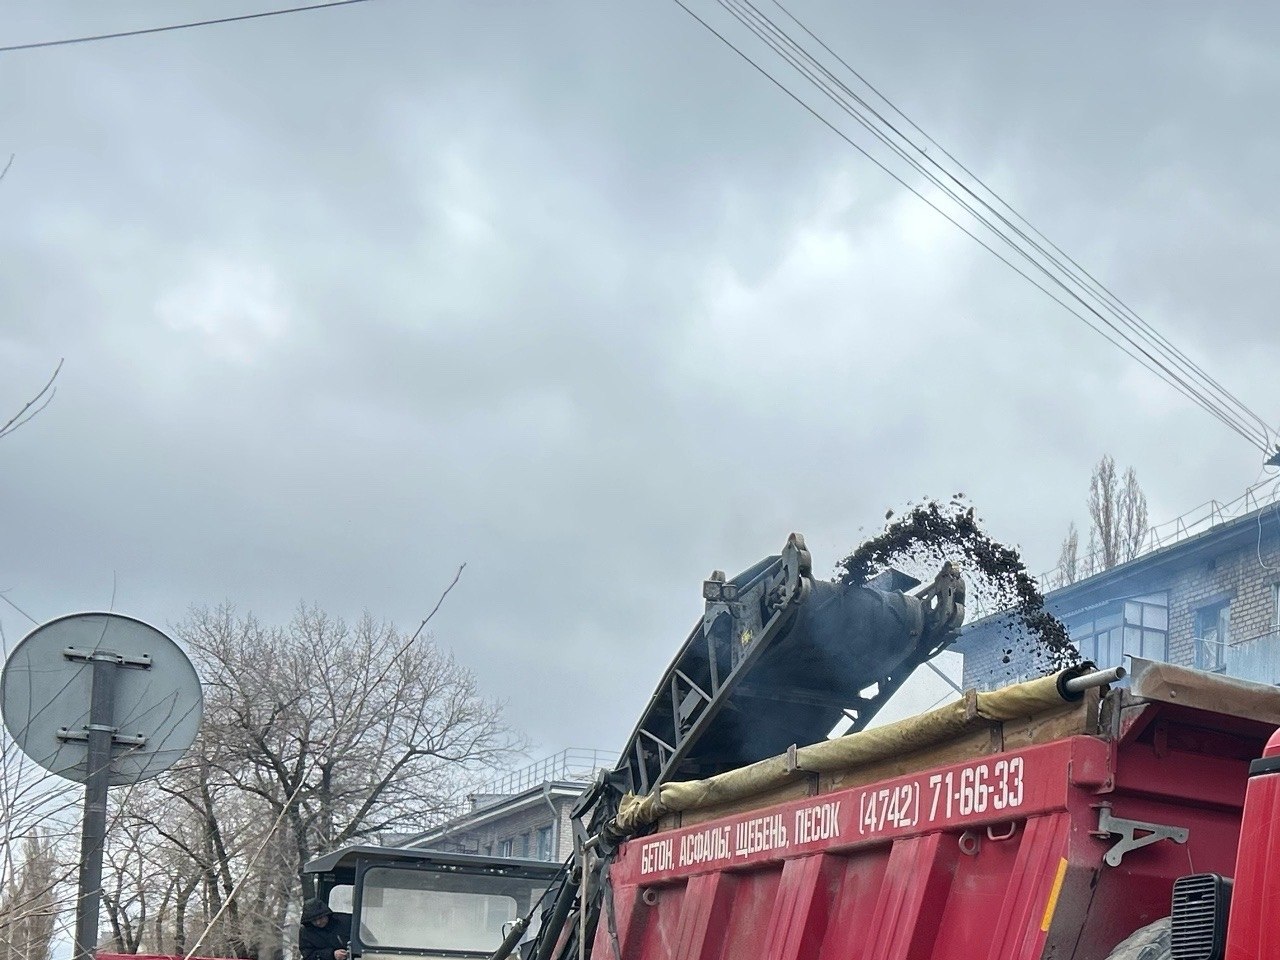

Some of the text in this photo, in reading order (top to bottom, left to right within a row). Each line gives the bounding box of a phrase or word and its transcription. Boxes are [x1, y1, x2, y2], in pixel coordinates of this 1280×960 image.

[641, 757, 1024, 875] БЕТОН, АСФАЛЬТ, ЩЕБЕНЬ, ПЕСОК (4742) 71-66-33
